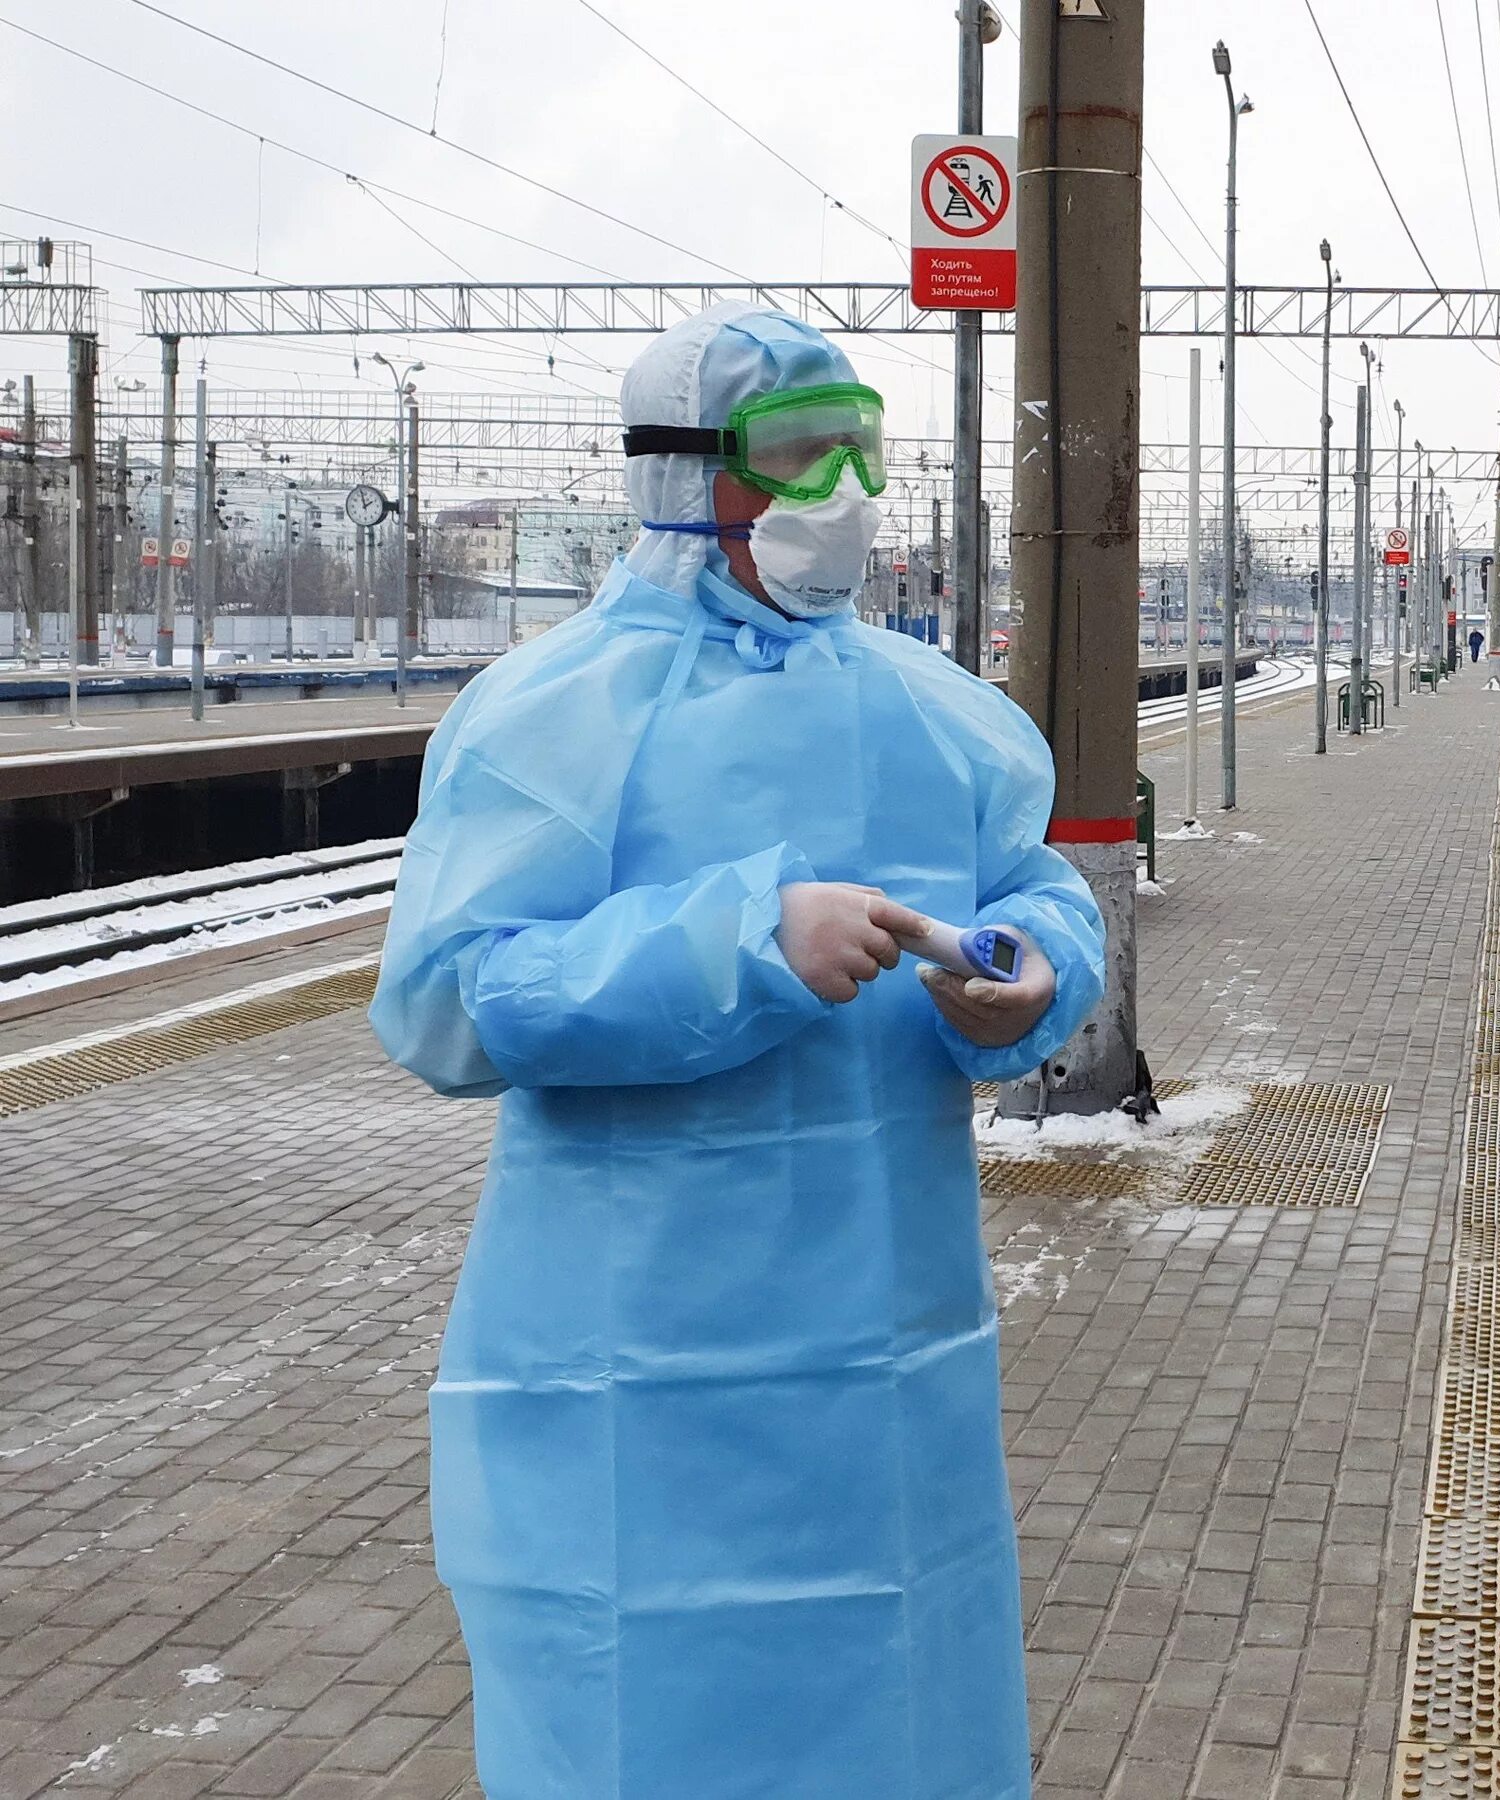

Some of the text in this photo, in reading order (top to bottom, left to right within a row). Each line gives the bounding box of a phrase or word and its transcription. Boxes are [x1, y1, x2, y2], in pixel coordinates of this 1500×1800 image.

[930, 258, 973, 270] Ходить
[930, 274, 982, 286] по путям
[930, 287, 999, 297] запрещено!
